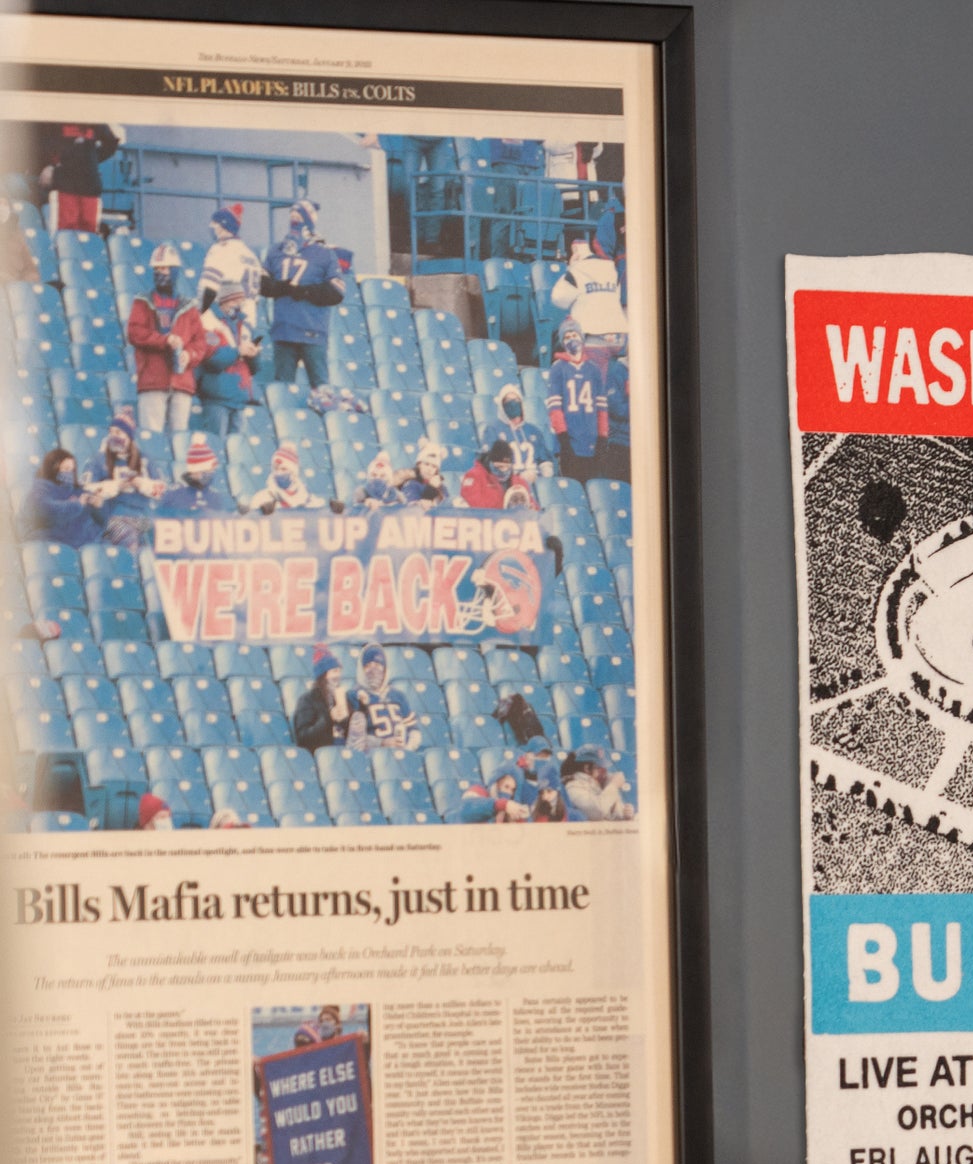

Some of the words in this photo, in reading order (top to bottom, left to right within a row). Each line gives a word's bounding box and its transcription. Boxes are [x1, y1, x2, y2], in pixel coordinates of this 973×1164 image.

[162, 75, 198, 93] NFL
[200, 77, 289, 97] PLAYOFFS:
[292, 81, 339, 98] BILLS
[342, 86, 360, 99] vs.
[362, 84, 416, 102] COLTS
[567, 379, 594, 413] 14
[154, 517, 306, 554] BUNDLE
[317, 517, 369, 553] UP
[376, 516, 544, 554] AMERICA
[154, 556, 317, 641] WE'RE
[327, 552, 472, 639] BACK
[14, 883, 101, 925] Bills
[108, 881, 223, 922] Mafia
[232, 887, 381, 924] returns,
[384, 876, 457, 925] just
[464, 875, 501, 913] in
[509, 873, 590, 912] time
[270, 1069, 316, 1099] WHERE
[319, 1061, 356, 1087] ELSE
[839, 1055, 919, 1090] LIVE
[930, 1055, 973, 1087] AT
[274, 1100, 322, 1129] WOULD
[326, 1093, 358, 1117] YOU
[289, 1128, 346, 1158] RATHER
